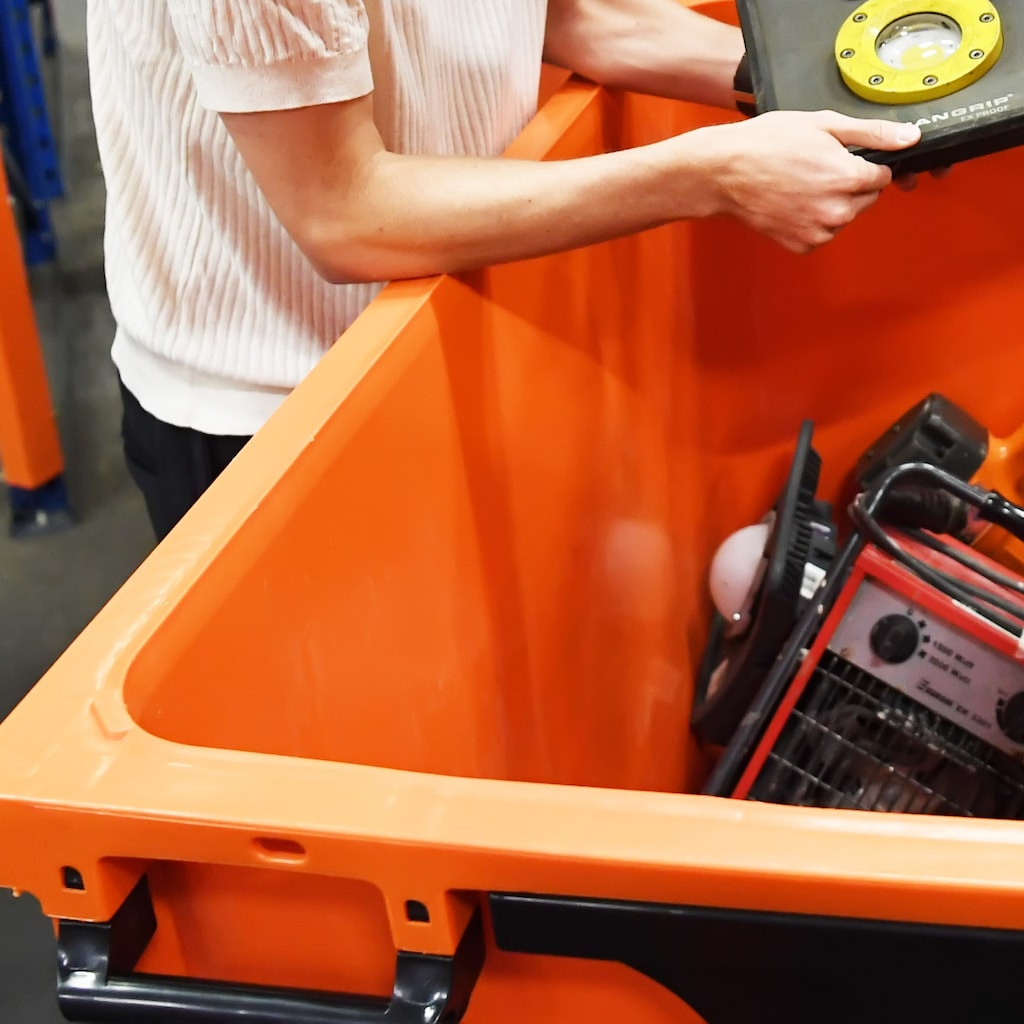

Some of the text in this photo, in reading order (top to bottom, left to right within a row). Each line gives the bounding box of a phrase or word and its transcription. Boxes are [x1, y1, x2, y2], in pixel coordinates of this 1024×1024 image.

[905, 95, 1010, 127] ANGRIP
[960, 105, 1009, 123] EX PROOF
